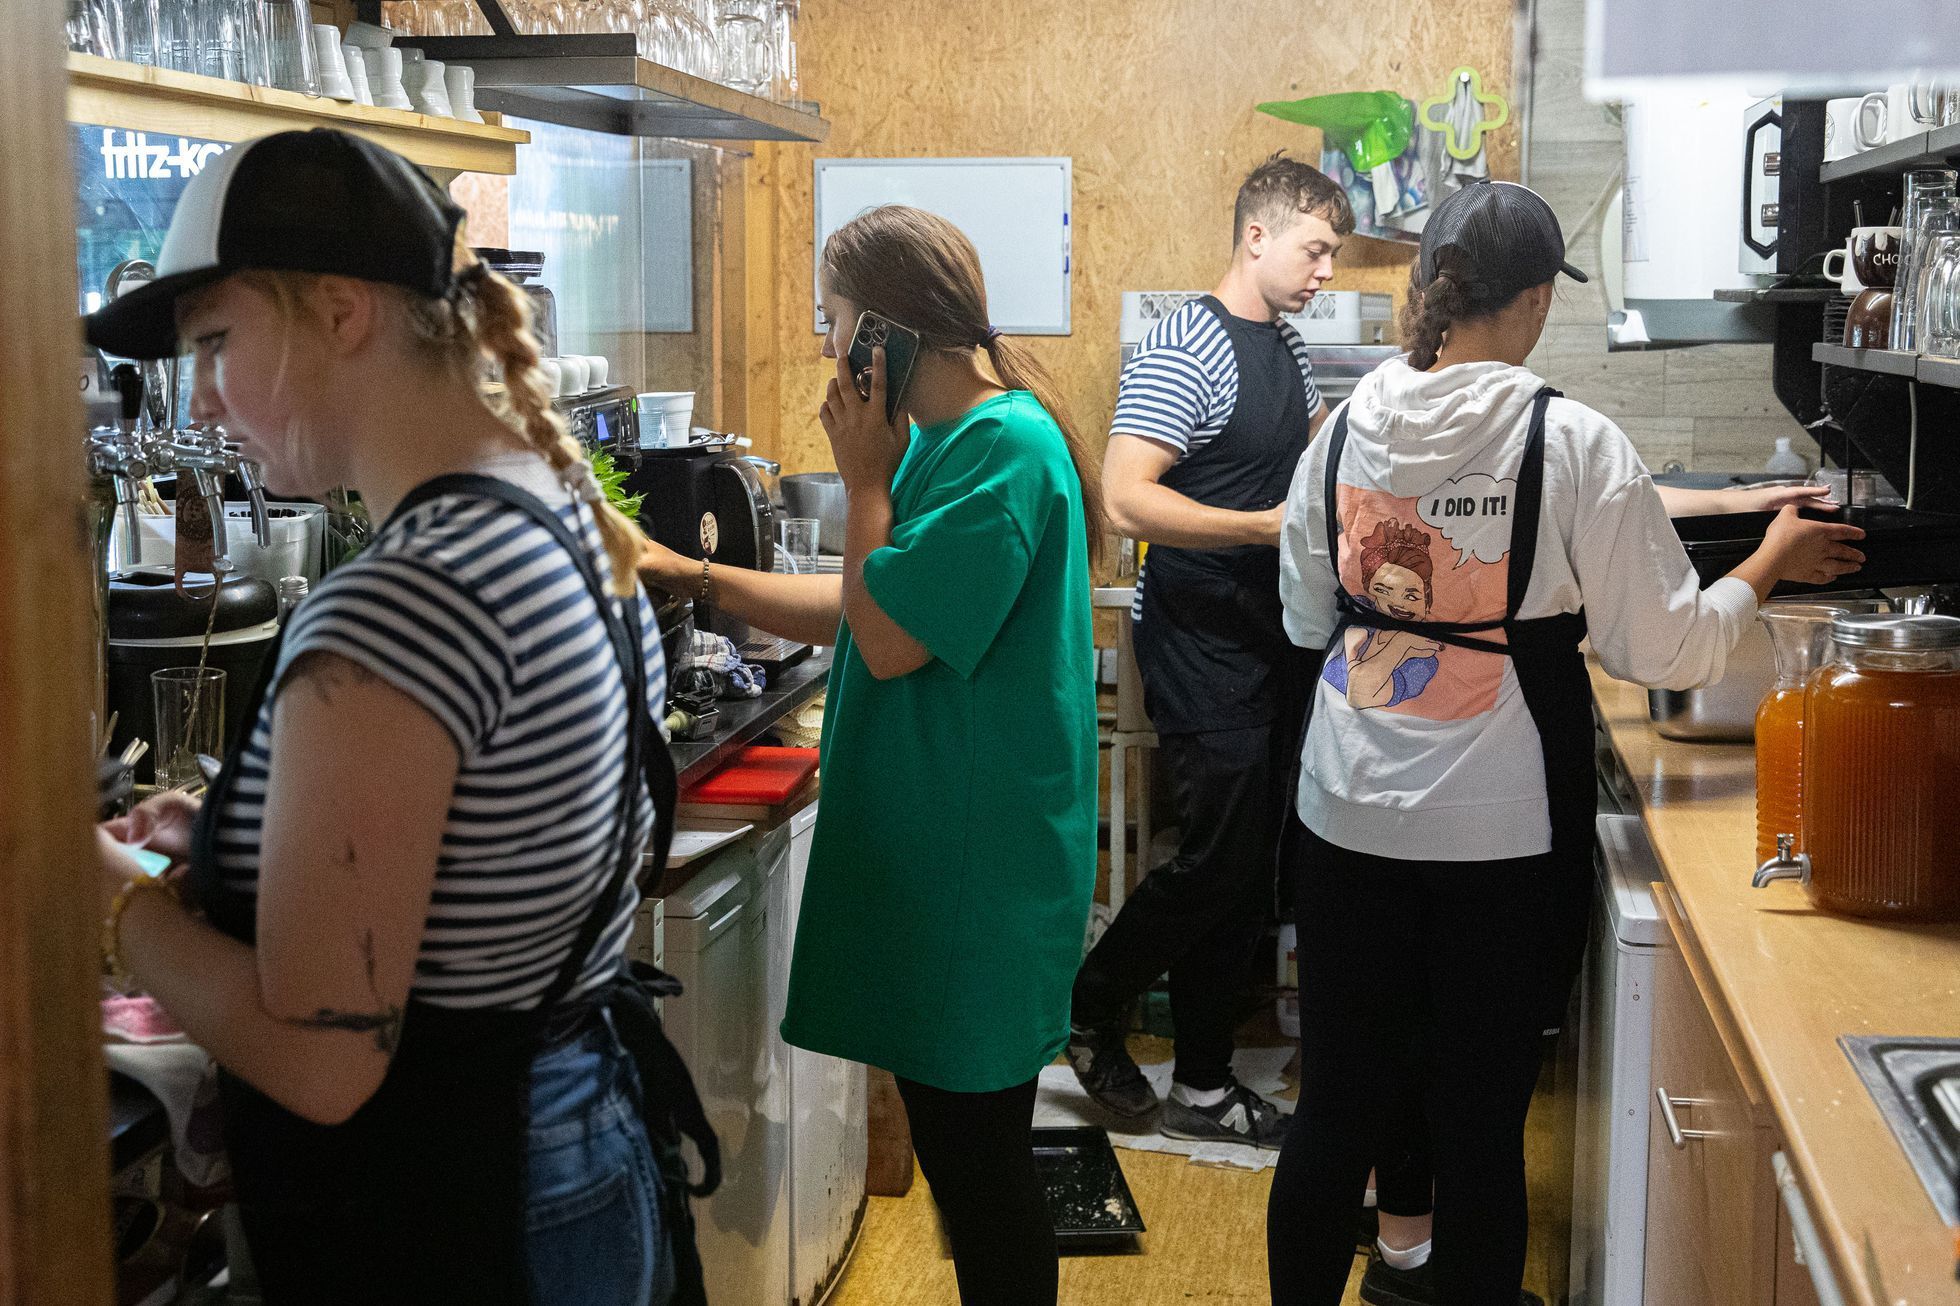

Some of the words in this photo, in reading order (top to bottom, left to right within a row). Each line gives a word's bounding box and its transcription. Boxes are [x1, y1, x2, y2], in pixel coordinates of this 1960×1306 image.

[1430, 499, 1440, 516] I
[1444, 497, 1475, 516] DID
[1481, 495, 1507, 516] IT!
